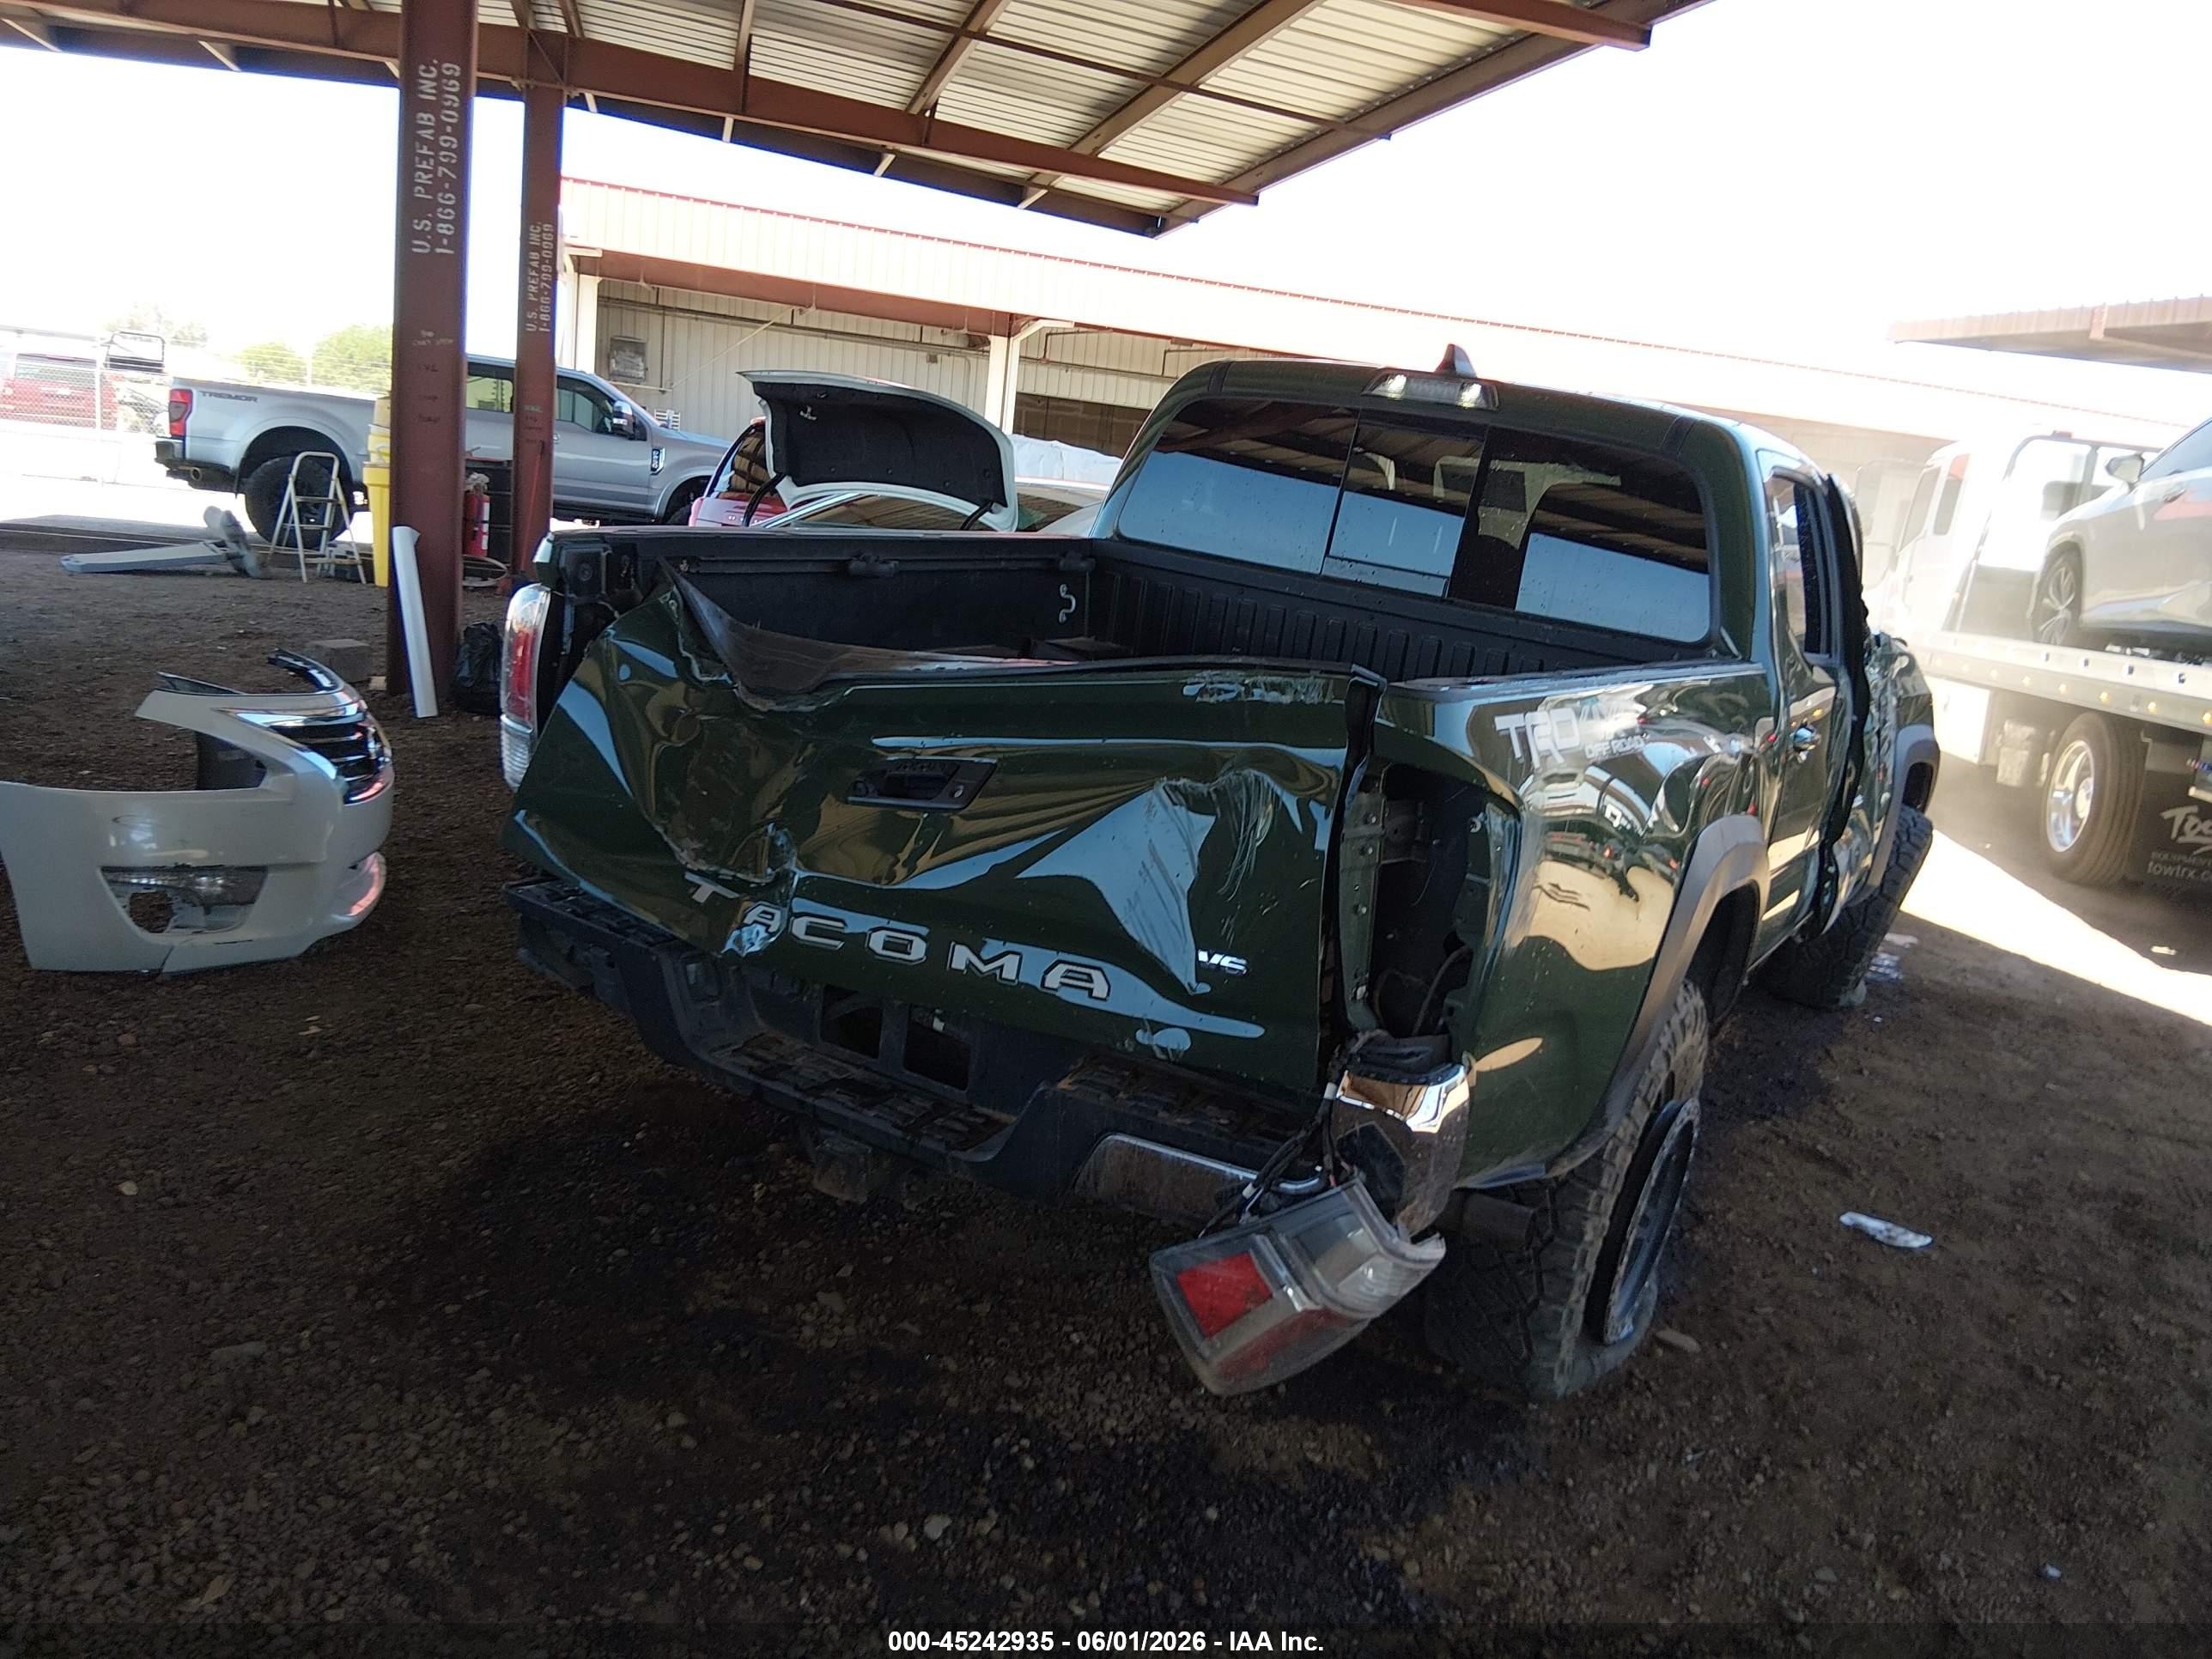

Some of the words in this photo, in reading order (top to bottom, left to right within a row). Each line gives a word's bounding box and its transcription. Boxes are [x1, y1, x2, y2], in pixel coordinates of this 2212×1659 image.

[417, 58, 438, 100] INC.
[413, 111, 436, 199] PREFAB
[434, 62, 462, 255] 1-866-799-0969
[411, 213, 432, 254] U.S.
[527, 251, 541, 302] PREFAB
[198, 390, 258, 403] TREMOR
[1494, 707, 1581, 771] TRD
[1585, 740, 1613, 760] OFF
[684, 871, 1114, 1001] TACOMA
[1197, 949, 1249, 975] V6
